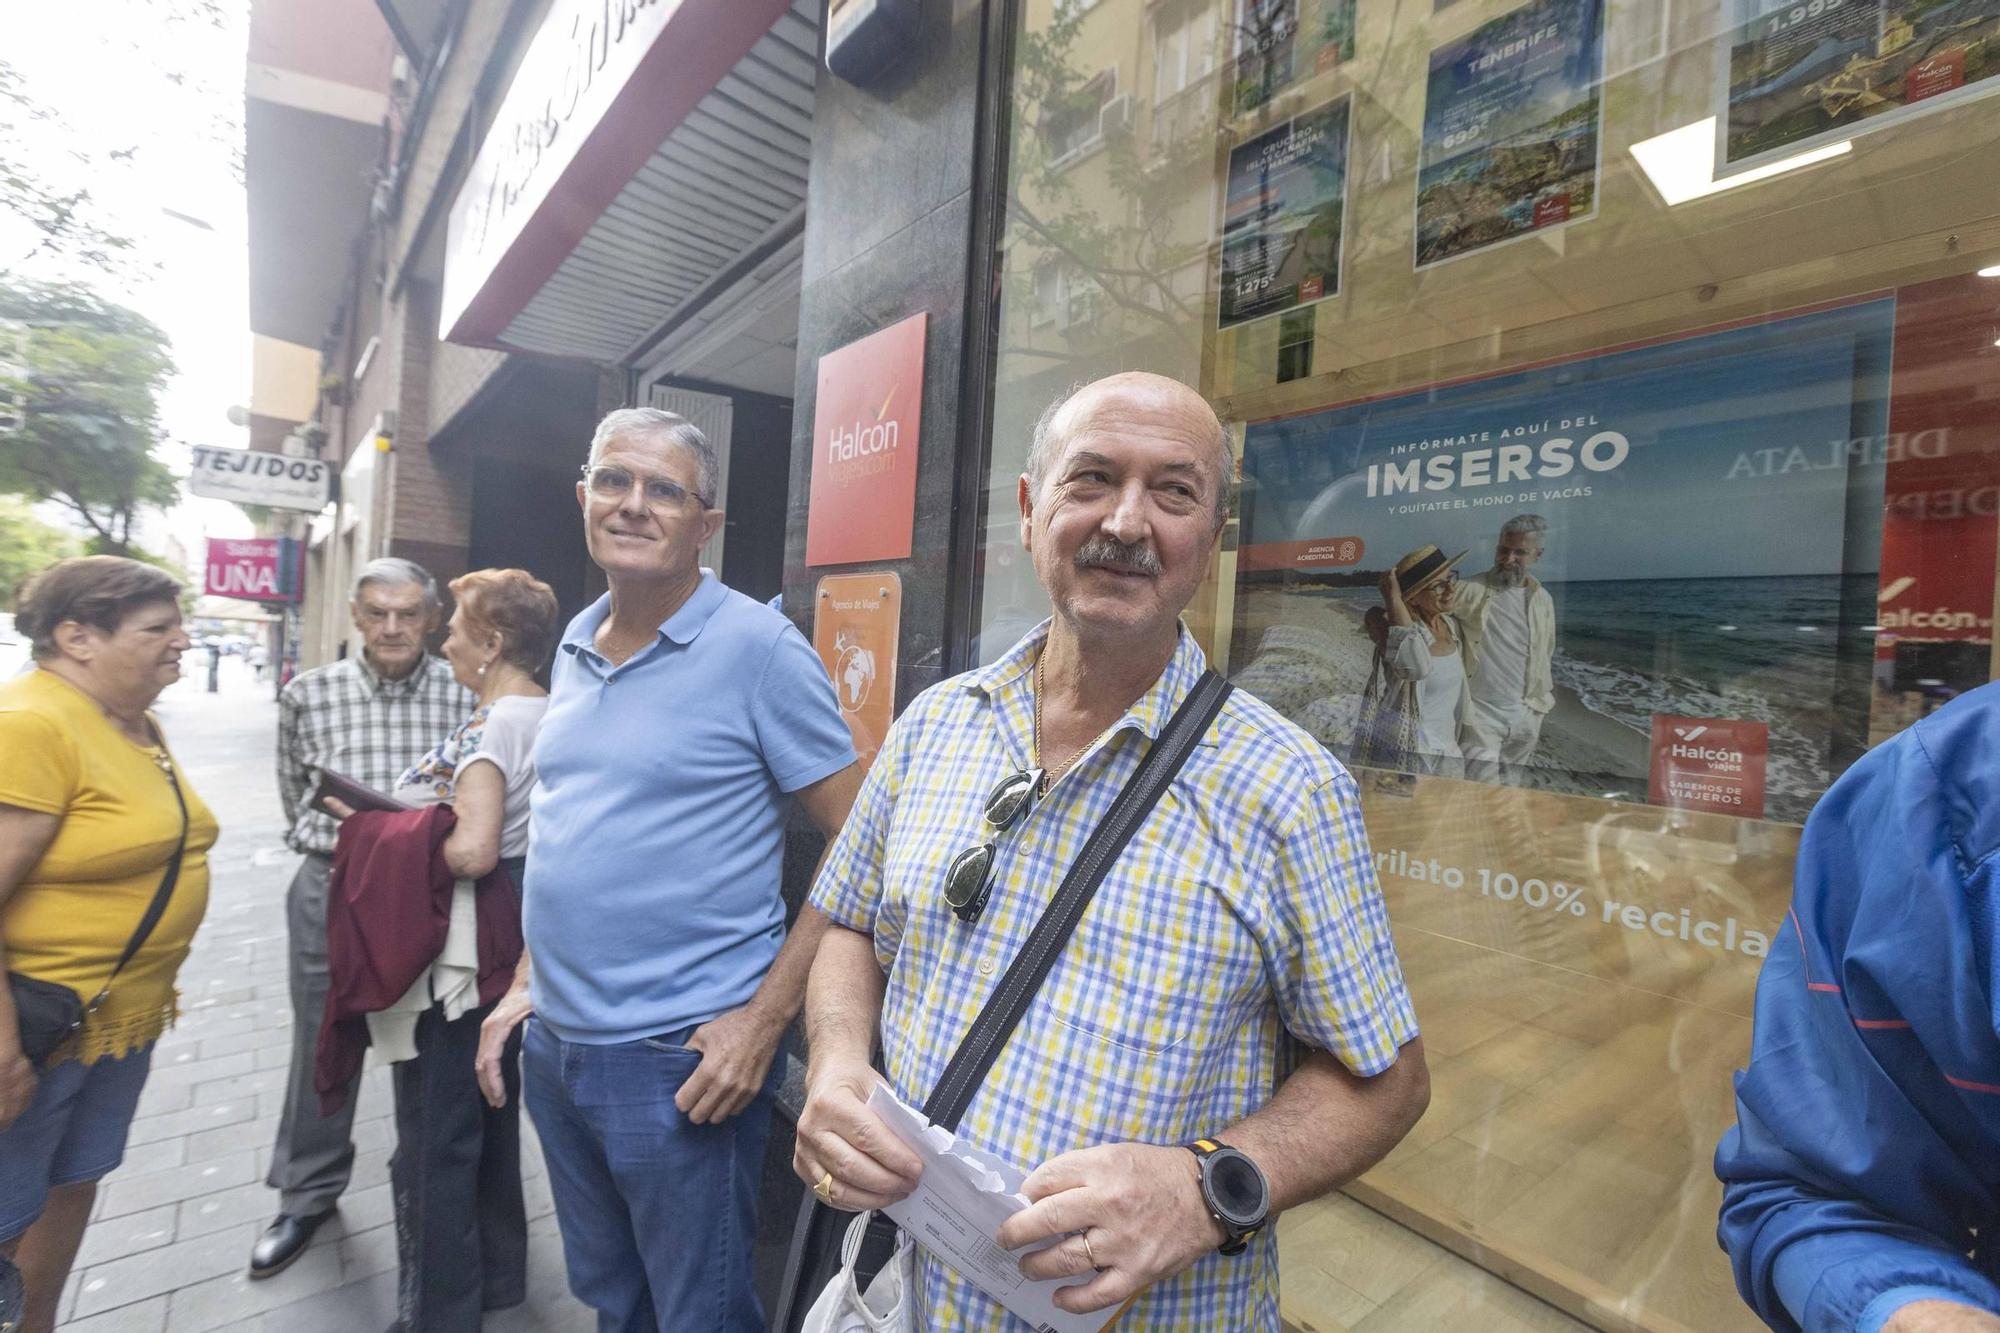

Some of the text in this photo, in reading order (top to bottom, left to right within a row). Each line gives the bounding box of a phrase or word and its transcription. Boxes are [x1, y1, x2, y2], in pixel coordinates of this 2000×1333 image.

[1468, 23, 1559, 74] TENERIFE
[1246, 130, 1326, 172] ISLAS CANARIAS
[1262, 126, 1313, 156] CRUCERO
[1269, 145, 1313, 170] MADEIRA
[1391, 415, 1599, 456] INFÓRMATE AQUÍ DEL
[193, 447, 323, 482] TEJIDOS
[1367, 431, 1630, 498] IMSERSO
[1388, 486, 1593, 515] Y QUÍTATE EL MONO DE VACAS
[1297, 553, 1335, 561] ACREDITADA
[832, 600, 880, 613] Agencia de Viajes
[1877, 607, 1977, 628] alcón
[1671, 744, 1743, 762] Halcón
[1707, 761, 1743, 772] viajes
[1669, 780, 1743, 795] SABEMOS DE
[1669, 788, 1742, 805] VIAJEROS
[1372, 850, 1464, 889] rilato
[1477, 868, 1587, 917] 100%
